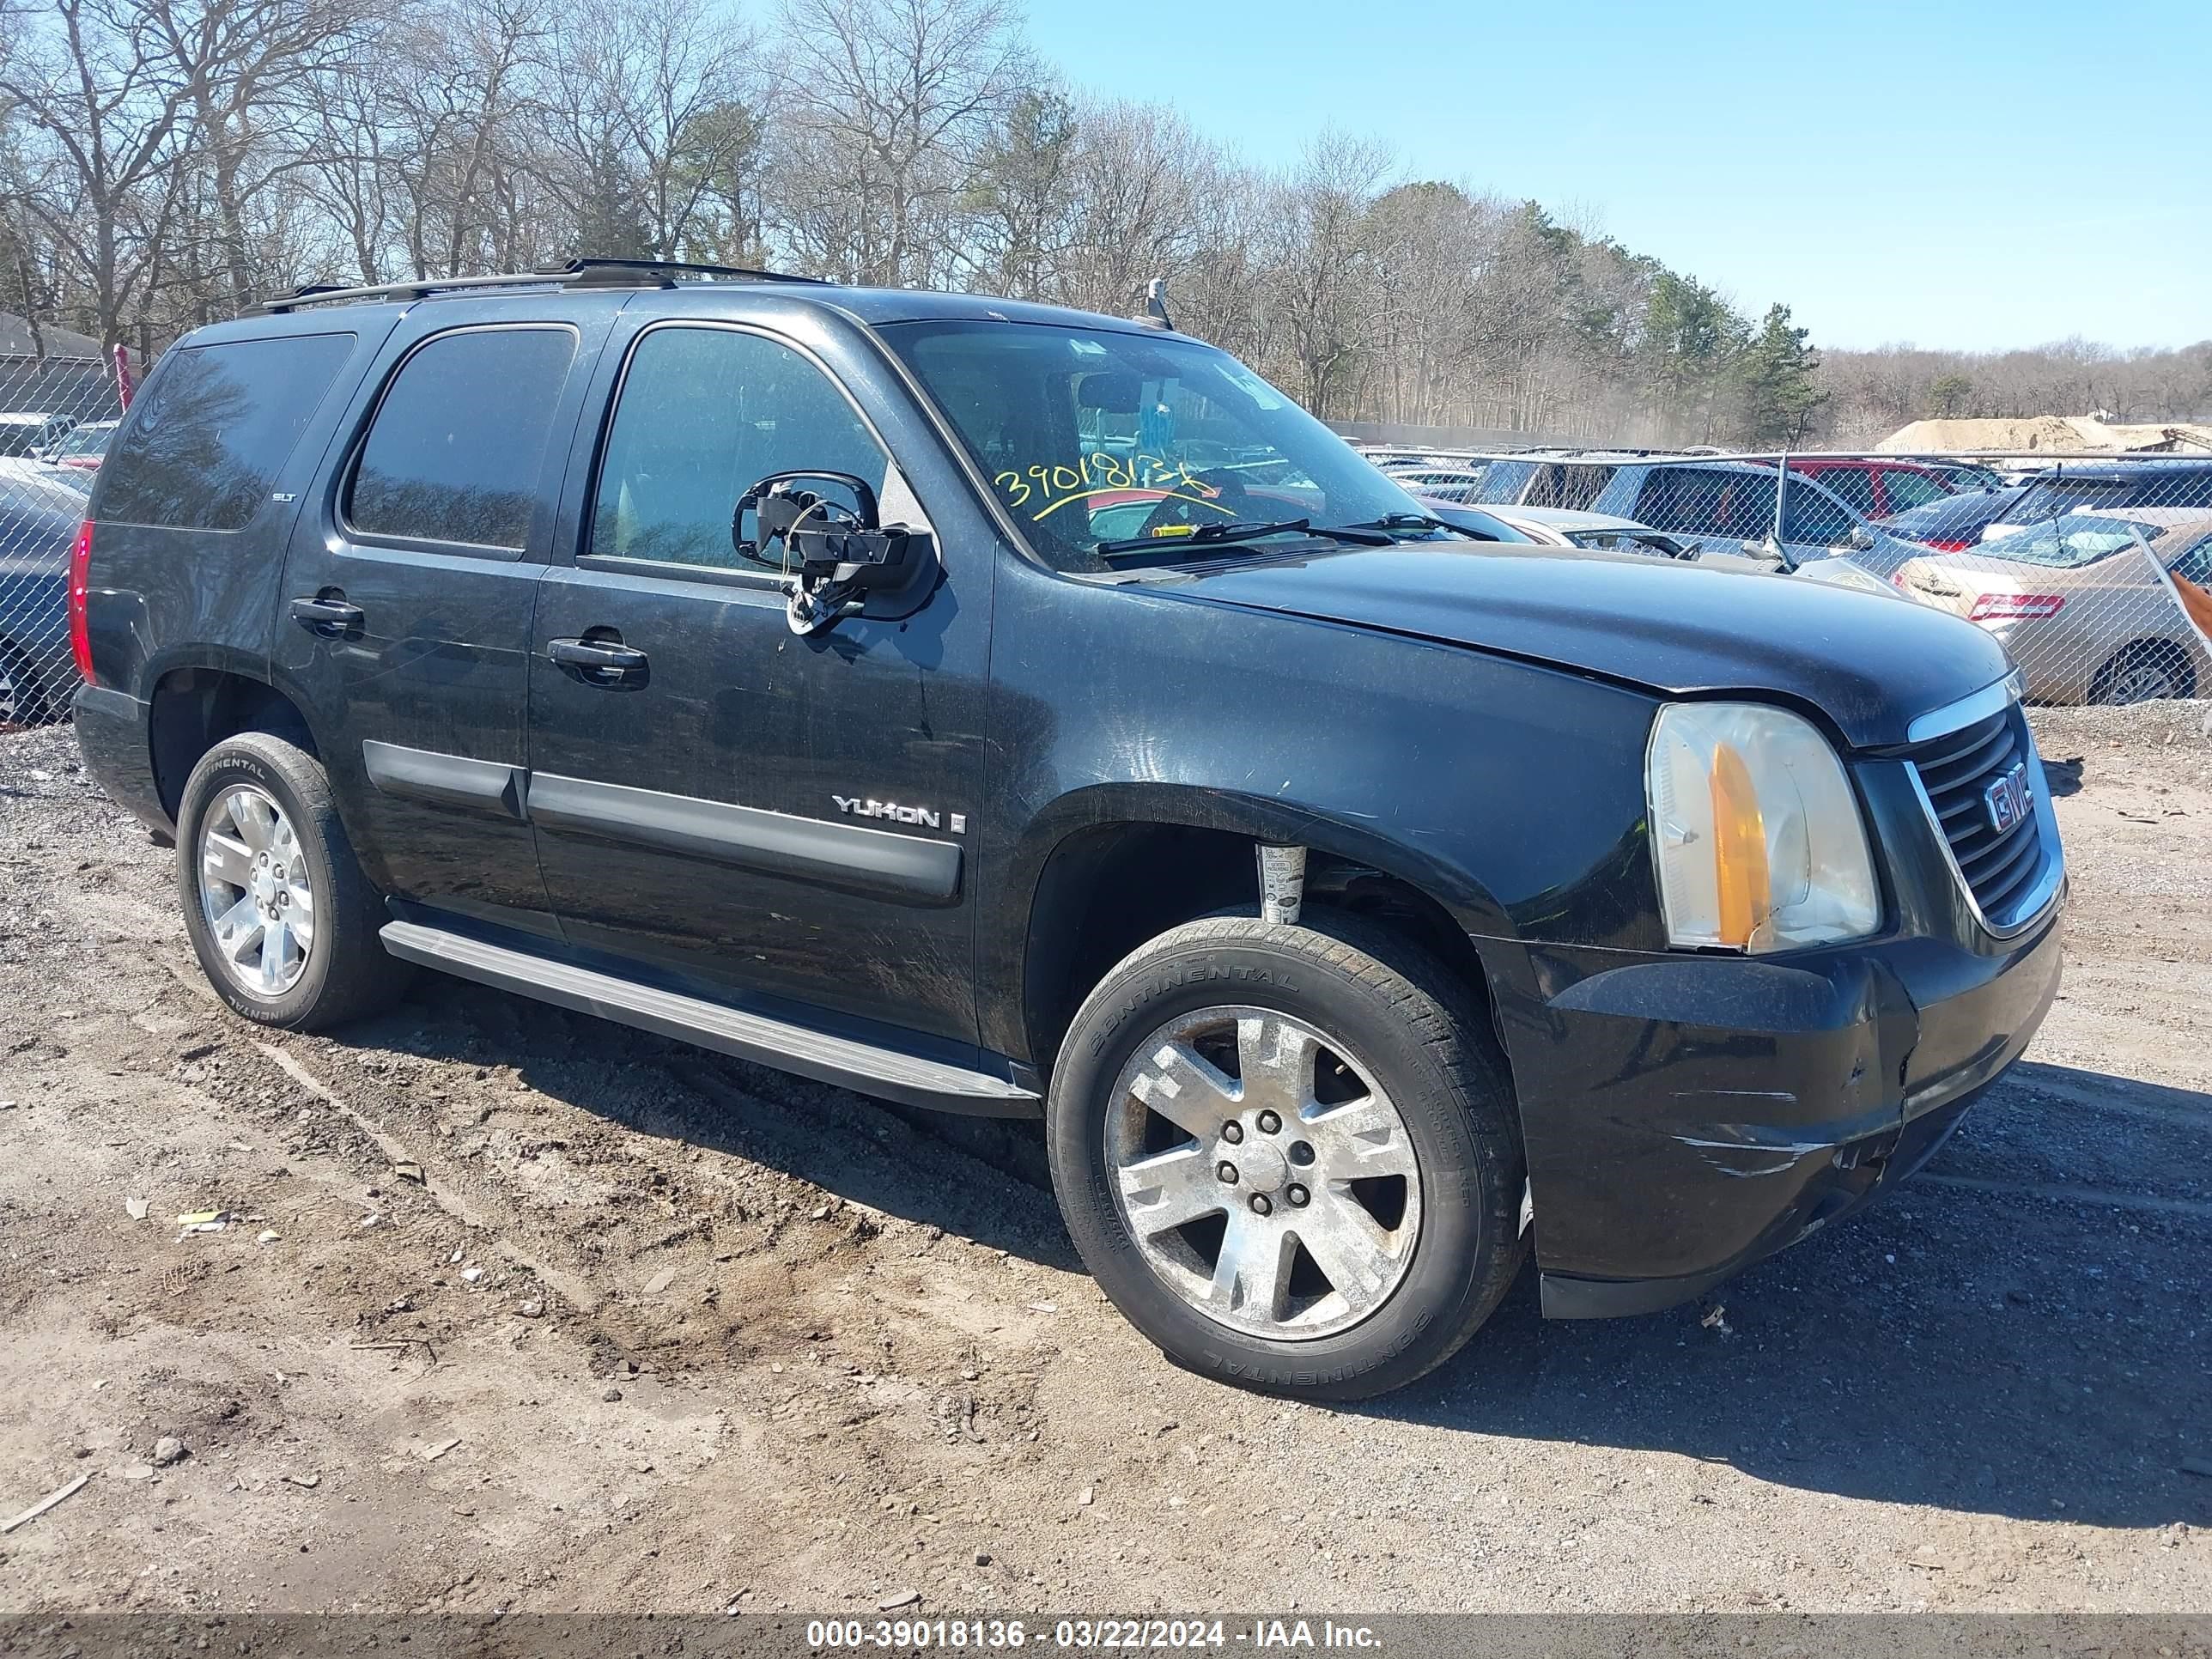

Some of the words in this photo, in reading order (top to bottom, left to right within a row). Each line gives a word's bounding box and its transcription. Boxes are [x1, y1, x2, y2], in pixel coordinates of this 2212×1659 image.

[272, 493, 297, 502] SLT
[831, 794, 940, 829] YUKON
[1984, 762, 2034, 834] GMC
[1087, 963, 1299, 1057] CONTINENTAL
[1203, 1304, 1437, 1386] CONTINENTAL
